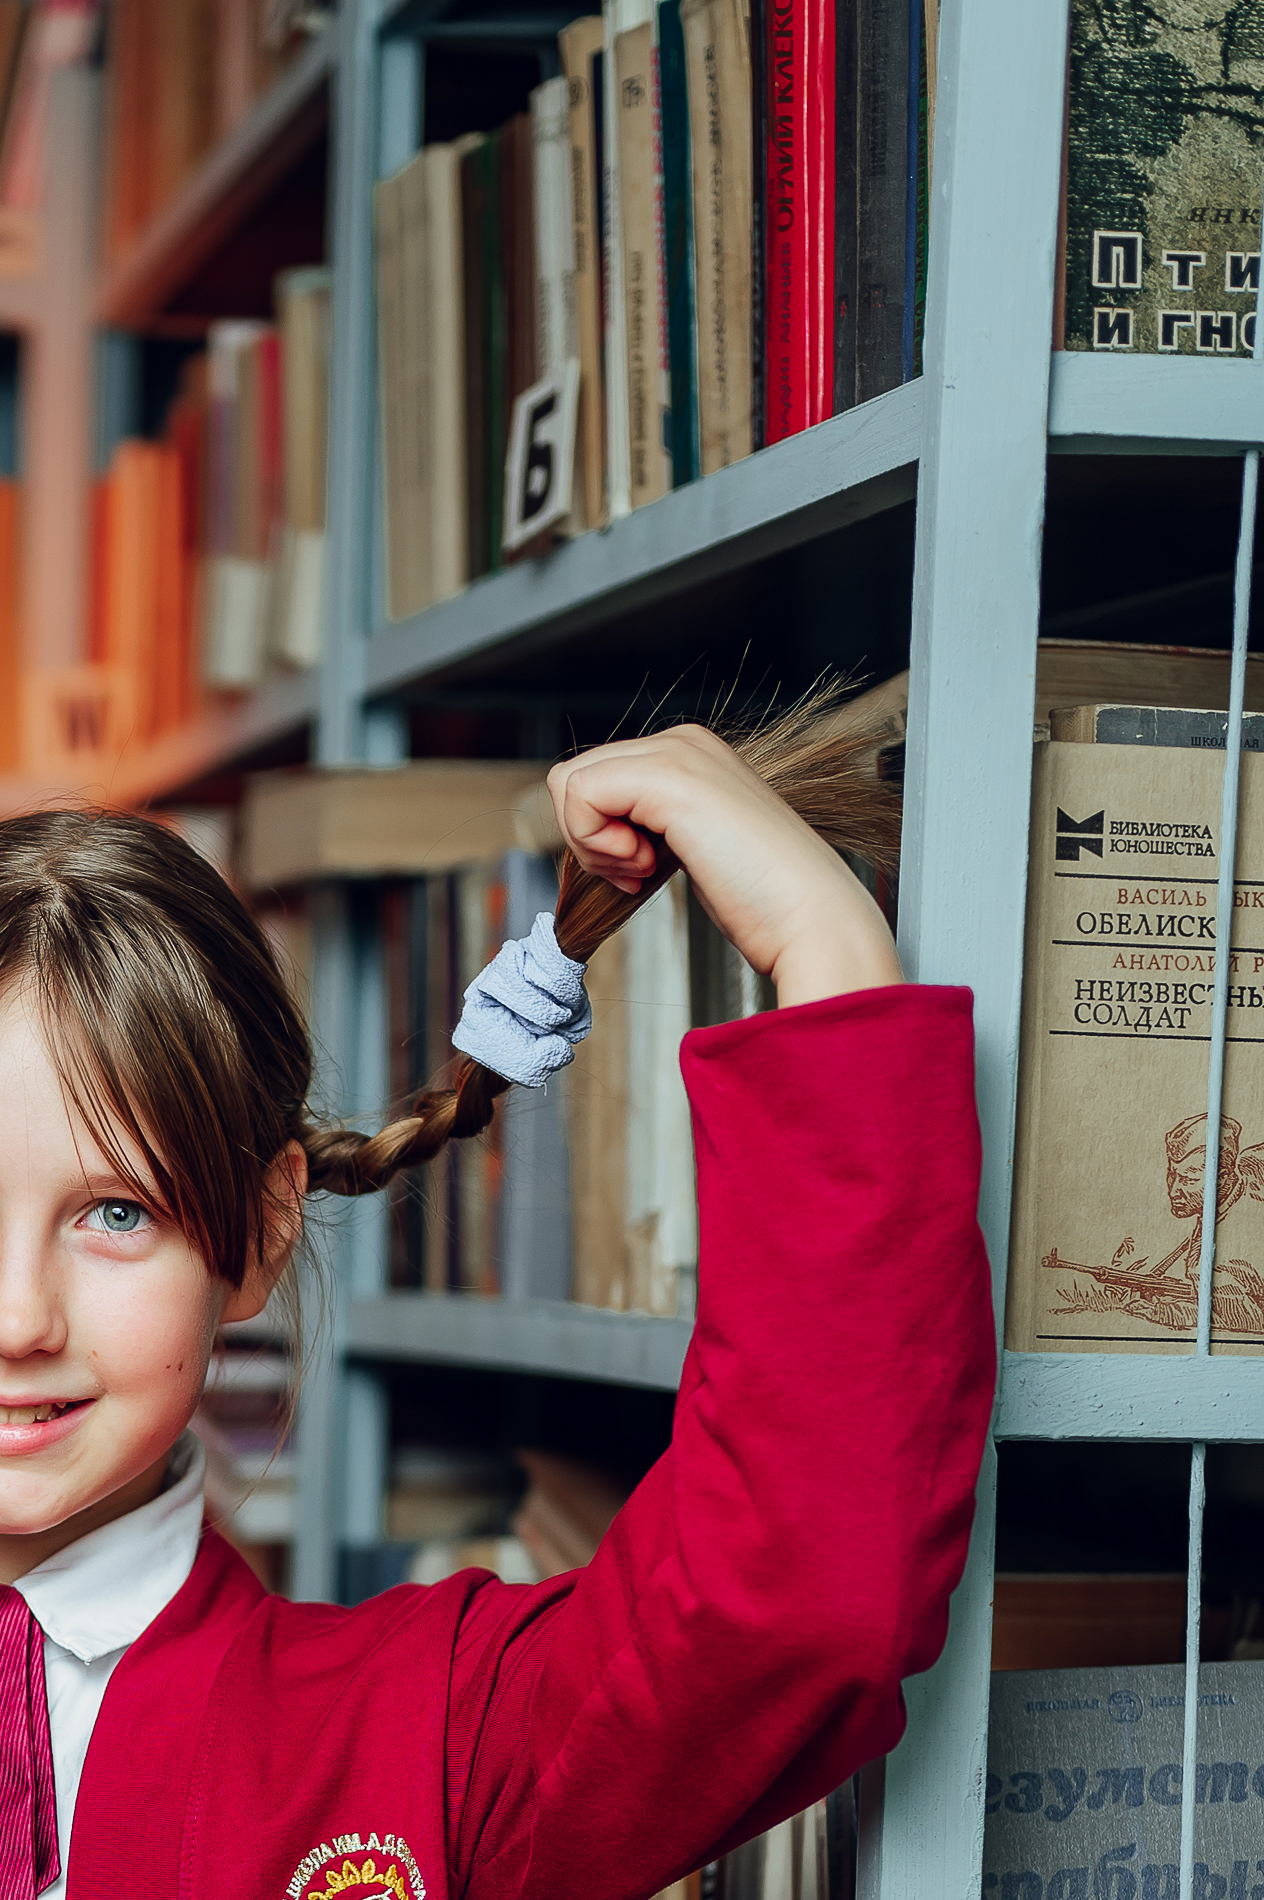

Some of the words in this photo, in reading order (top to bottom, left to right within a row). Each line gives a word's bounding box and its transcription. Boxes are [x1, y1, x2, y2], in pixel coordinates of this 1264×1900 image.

[1190, 736, 1260, 749] ШКОЛАЯ
[1109, 820, 1213, 841] БИБЛИОТЕКА
[1109, 838, 1216, 858] ЮНОШЕСТВА
[1116, 887, 1207, 907] ВАСИЛЬ
[1076, 911, 1218, 939] ОБЕЛИСК
[1074, 1003, 1192, 1033] СОЛДАТ
